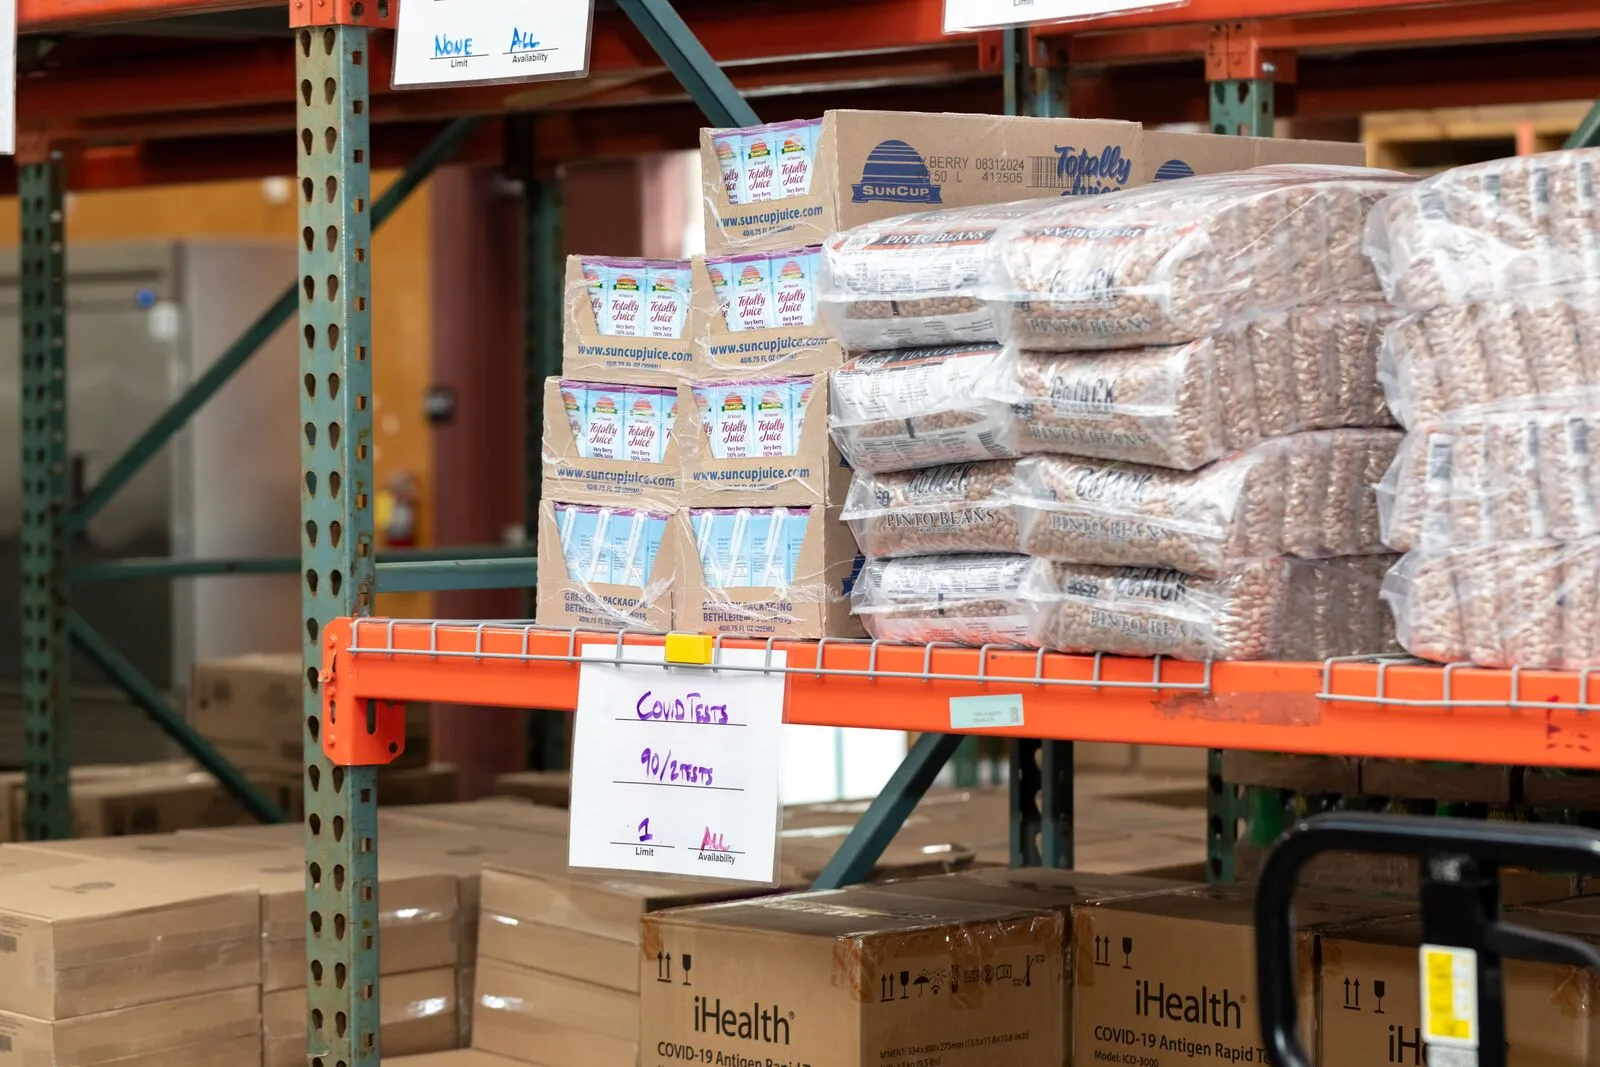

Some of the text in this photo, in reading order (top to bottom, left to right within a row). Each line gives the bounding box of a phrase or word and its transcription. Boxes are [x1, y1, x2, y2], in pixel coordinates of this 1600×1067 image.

[434, 26, 540, 57] NONE ALL
[450, 59, 468, 68] Limit
[512, 53, 548, 64] Availability
[781, 160, 808, 175] Totally
[975, 157, 1024, 171] 08312024
[1055, 144, 1131, 184] Totally
[748, 164, 773, 181] Totally
[782, 173, 804, 186] Juice
[956, 172, 962, 182] L
[982, 172, 1022, 183] 412505
[749, 179, 770, 191] Juice
[738, 293, 765, 308] Totally
[777, 289, 805, 303] Totally
[612, 300, 639, 313] Totally
[650, 301, 677, 314] Totally
[740, 306, 762, 317] Juice
[778, 302, 801, 313] Juice
[612, 311, 635, 321] Juice
[650, 312, 672, 322] Juice
[1028, 316, 1151, 334] PINTO BEANS
[710, 336, 828, 355] www.suncupjuice.com
[578, 344, 693, 362] www.suncupjuice.com
[590, 422, 618, 438] Totally
[722, 420, 747, 434] Totally
[758, 418, 784, 432] Totally
[589, 433, 613, 445] Juice
[628, 425, 655, 440] Totally
[723, 432, 744, 443] Juice
[759, 431, 781, 443] Juice
[1029, 424, 1149, 445] PINTO BEANS
[628, 435, 650, 447] Juice
[557, 467, 675, 488] www.suncupjuice.com
[886, 508, 996, 527] PINTO BEANS
[1052, 514, 1169, 538] PINTO BEANS
[1089, 610, 1142, 631] PINTO
[637, 817, 731, 852] 1 ALL
[635, 847, 655, 857] Limit
[698, 852, 736, 865] Availability
[1135, 979, 1242, 1029] iHealth
[694, 995, 790, 1045] iHealth
[1094, 1026, 1271, 1064] COVID-19 Antigen Rapid Te
[657, 1041, 713, 1064] COVID-19
[715, 1050, 762, 1067] Antigen
[1094, 1049, 1159, 1067] Model: ICO-3000
